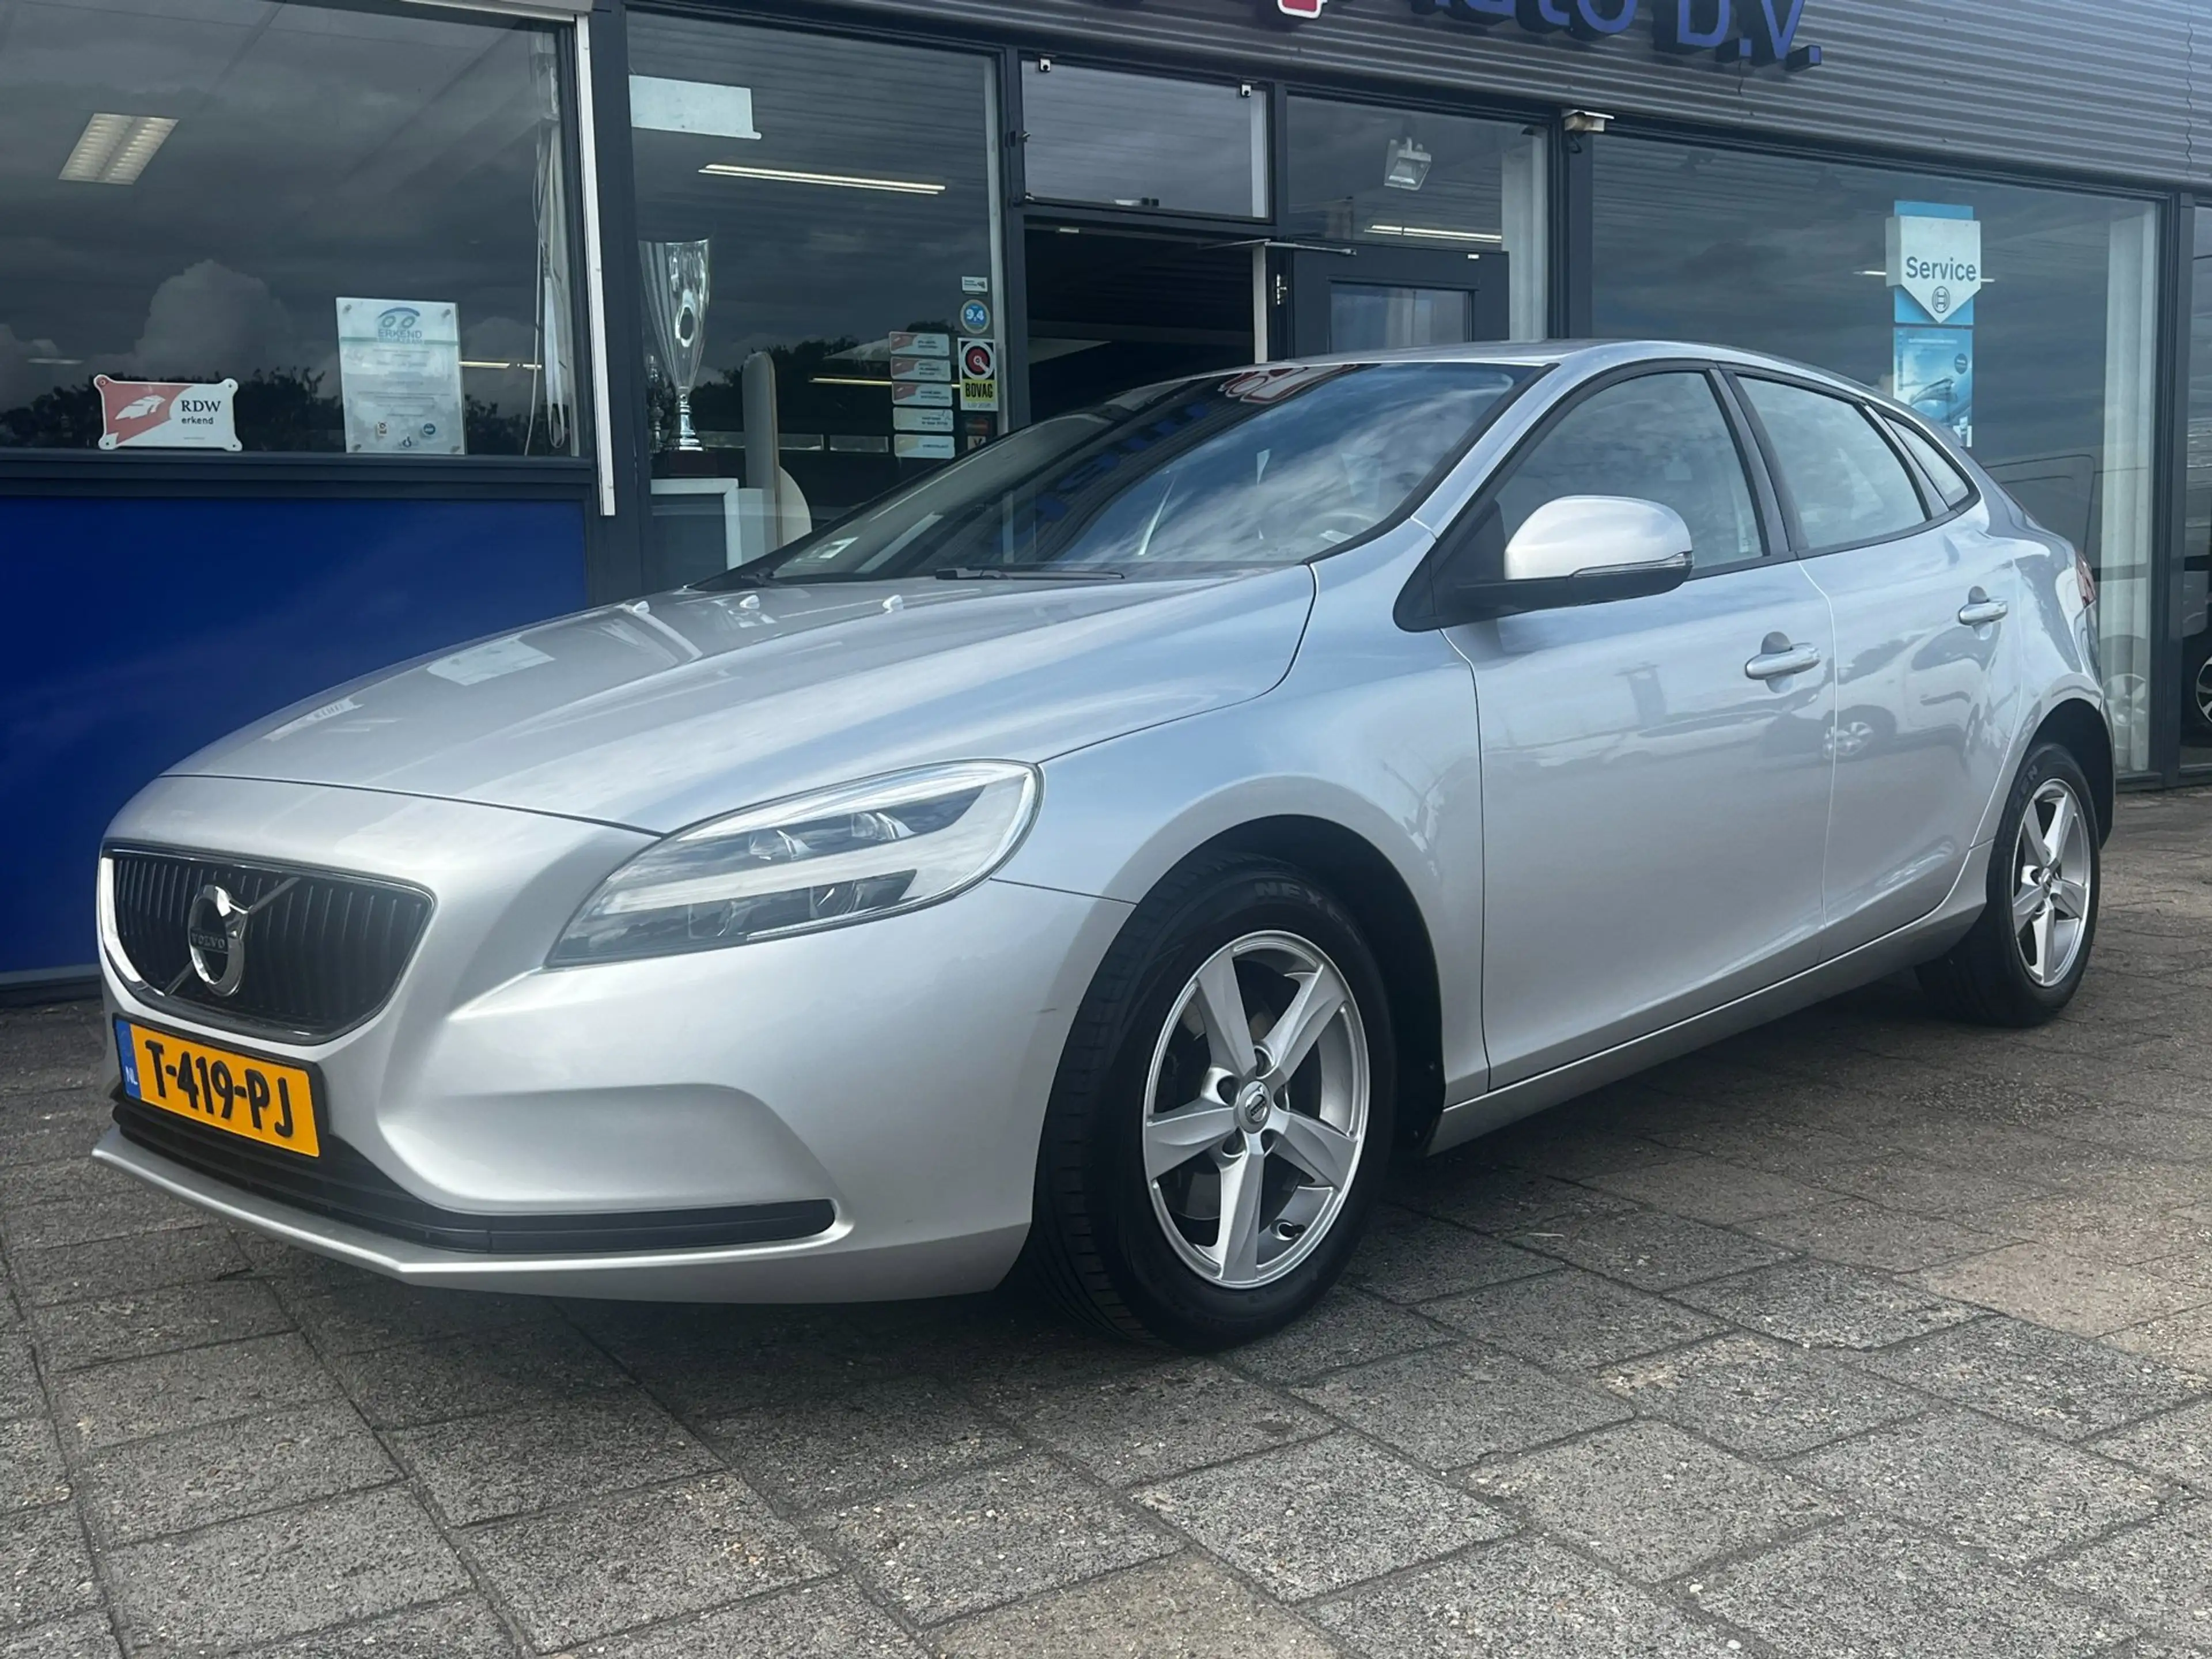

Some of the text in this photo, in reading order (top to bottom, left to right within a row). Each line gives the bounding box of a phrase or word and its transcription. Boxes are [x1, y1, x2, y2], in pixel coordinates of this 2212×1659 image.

[1906, 256, 1976, 282] Service
[378, 329, 422, 339] ERKEND
[965, 382, 993, 398] BOVAG
[181, 400, 221, 412] RDW
[181, 416, 214, 425] erkend
[191, 933, 226, 949] VOLVO
[125, 1066, 138, 1085] NL
[145, 1039, 294, 1138] T-419-PJ
